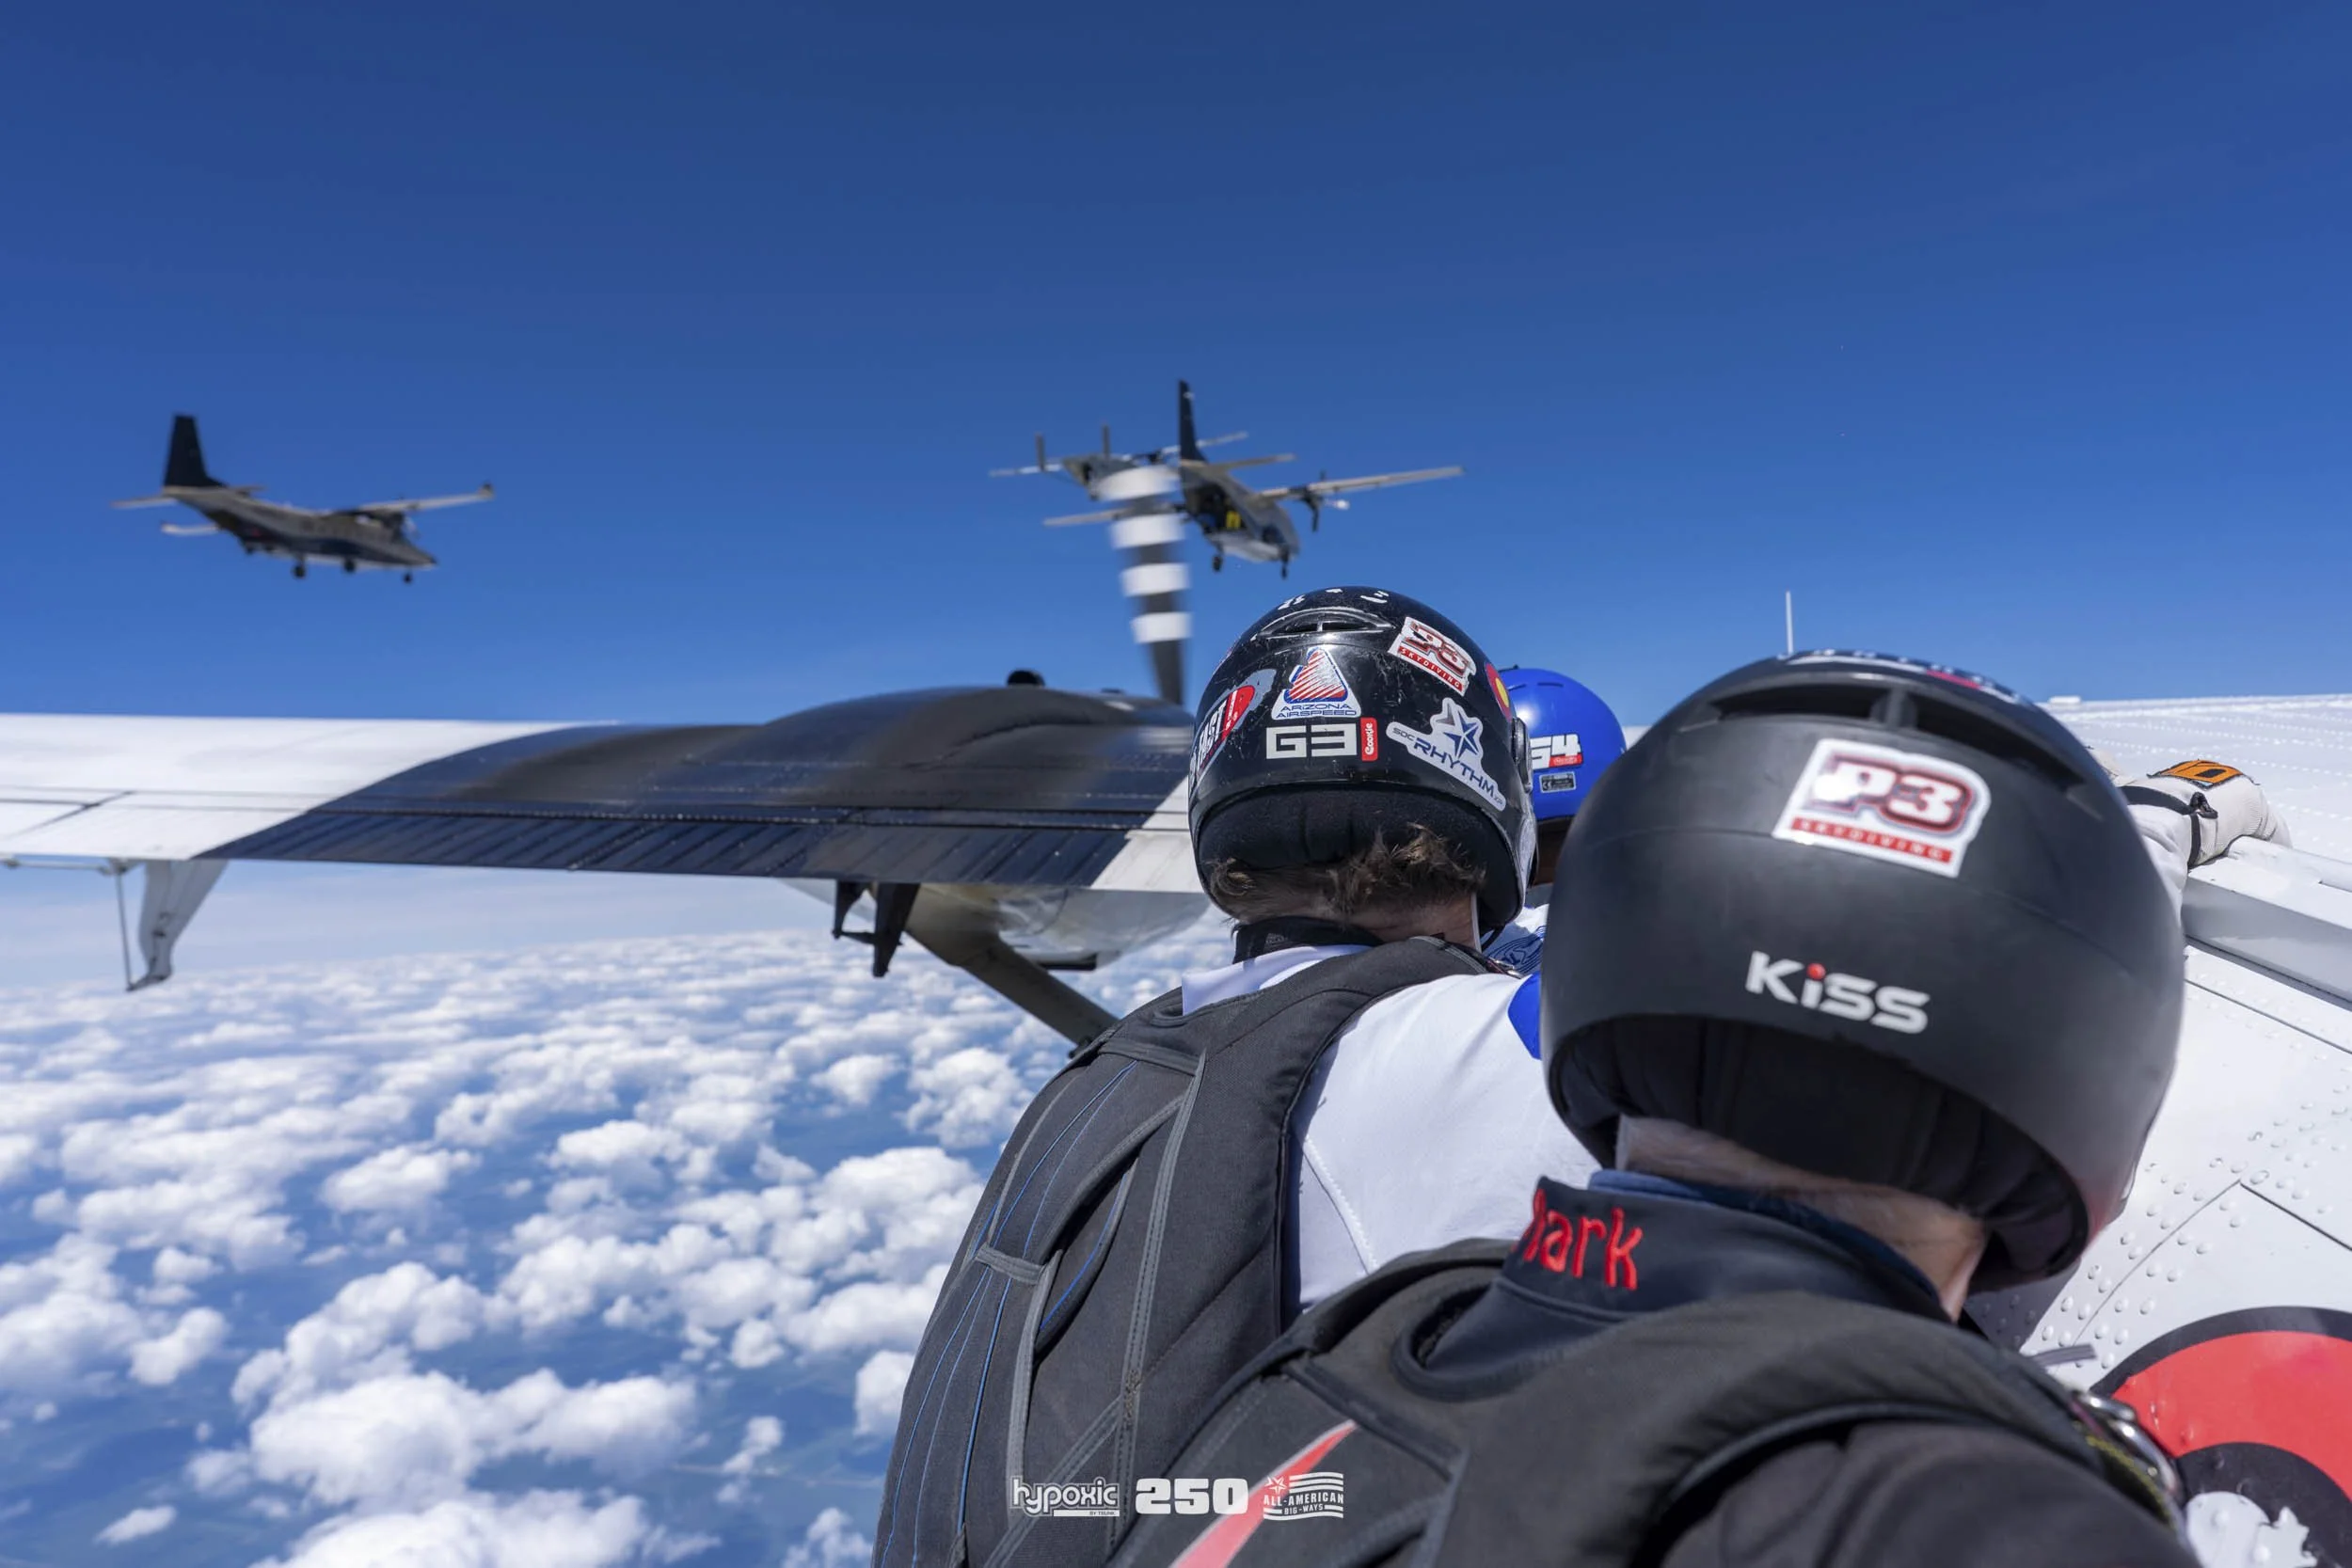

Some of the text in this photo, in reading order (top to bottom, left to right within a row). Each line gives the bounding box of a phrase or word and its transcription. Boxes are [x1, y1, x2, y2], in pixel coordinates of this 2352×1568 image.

[1400, 648, 1461, 688] SKYDIVING
[1276, 709, 1358, 719] AIRSPEED
[1265, 722, 1358, 760] G3
[1364, 722, 1375, 755] Cookie
[1392, 727, 1415, 741] SDC
[1413, 736, 1496, 798] RHYTHM
[1810, 755, 1972, 832] P3
